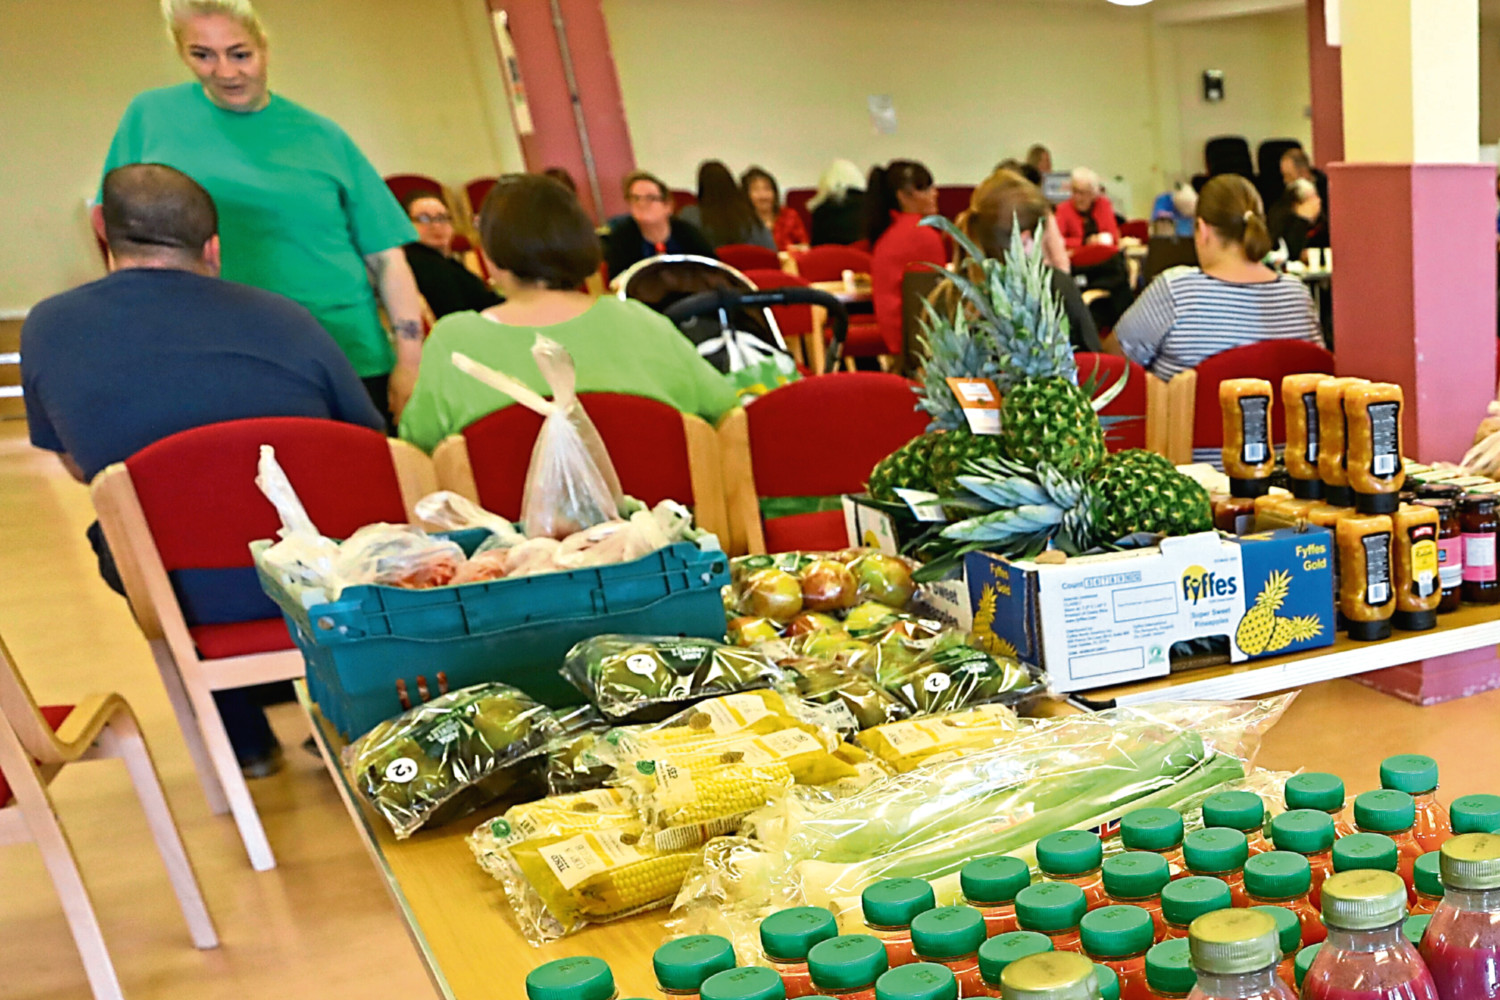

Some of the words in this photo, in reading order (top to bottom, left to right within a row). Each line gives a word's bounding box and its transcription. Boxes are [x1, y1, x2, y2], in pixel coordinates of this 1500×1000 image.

[1296, 544, 1326, 558] Fyffes
[1304, 558, 1327, 572] Gold
[1212, 607, 1230, 615] Sweet
